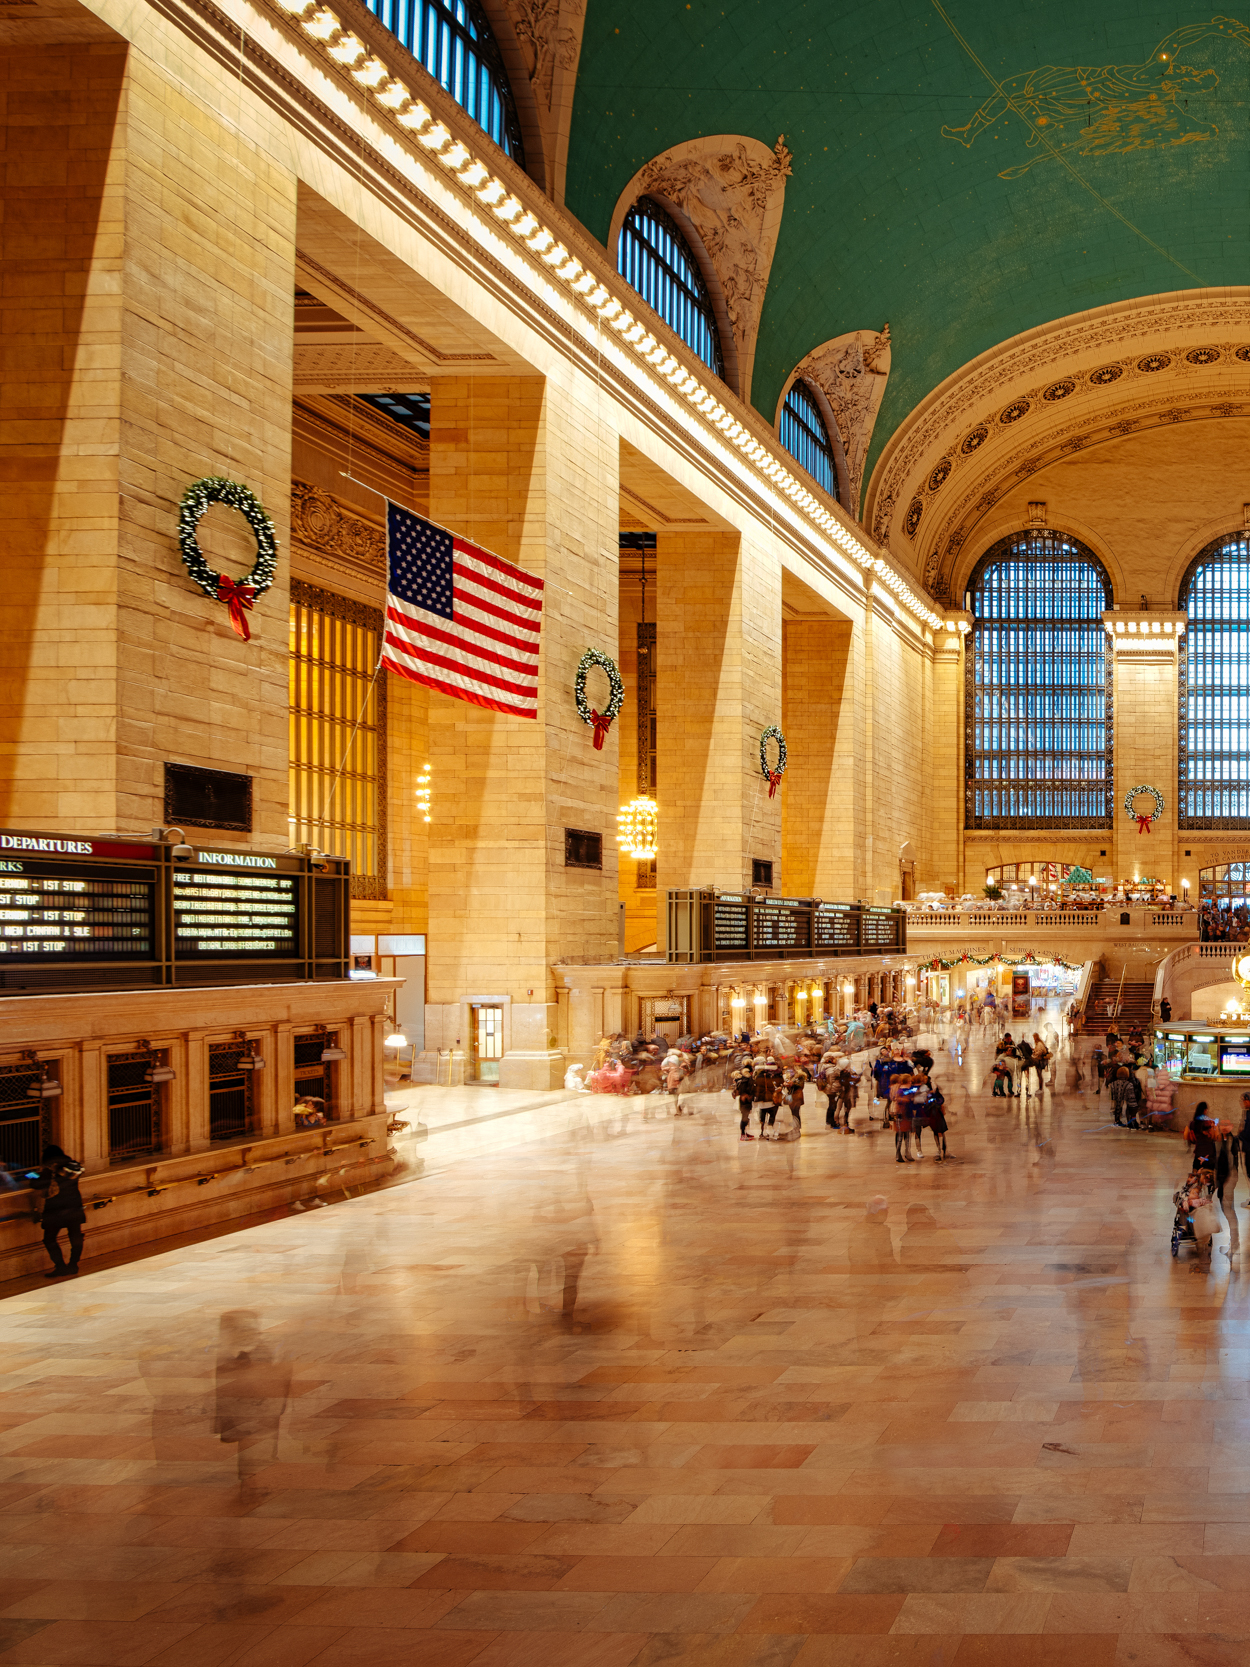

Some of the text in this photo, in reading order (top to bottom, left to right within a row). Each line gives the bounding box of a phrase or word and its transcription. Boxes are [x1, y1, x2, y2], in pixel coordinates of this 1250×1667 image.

[1, 835, 93, 853] DEPARTURES
[198, 852, 276, 868] INFORMATION
[174, 873, 191, 883] FREE
[43, 880, 59, 890] 1ST
[63, 881, 85, 891] STOP
[15, 895, 39, 904] STOP
[43, 911, 59, 920] 1ST
[63, 911, 85, 921] STOP
[23, 941, 39, 951] 1ST
[43, 941, 66, 951] STOP
[949, 946, 987, 957] MACHINES
